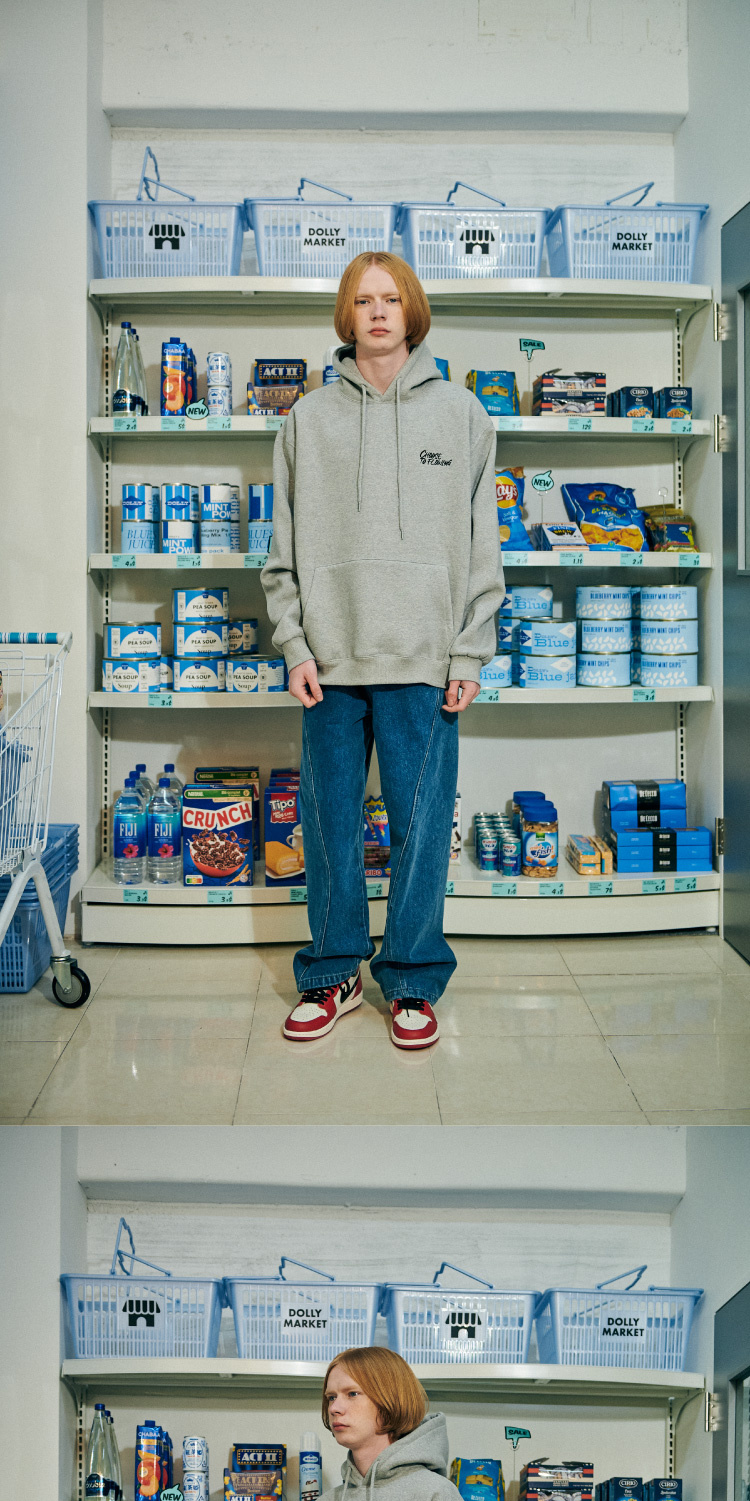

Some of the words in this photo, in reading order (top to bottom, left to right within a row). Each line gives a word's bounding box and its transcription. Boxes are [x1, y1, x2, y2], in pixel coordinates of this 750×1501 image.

[308, 228, 341, 236] DOLLY
[616, 232, 648, 240] DOLLY
[303, 238, 346, 247] MARKET
[611, 242, 653, 251] MARKET
[263, 367, 285, 376] ACT
[286, 366, 298, 376] II
[187, 407, 207, 415] NEW
[533, 478, 551, 488] NEW
[203, 503, 229, 512] MINT
[162, 539, 187, 547] MINT
[534, 638, 569, 648] Blue
[527, 671, 563, 681] Blue
[269, 798, 295, 812] Tipo
[183, 802, 252, 829] CRUNCH
[119, 823, 138, 837] FIJI
[154, 823, 173, 837] FIJI
[288, 1308, 322, 1318] DOLLY
[283, 1318, 328, 1329] MARKET
[607, 1317, 640, 1327] DOLLY
[602, 1327, 645, 1337] MARKET
[242, 1451, 263, 1462] ACT
[264, 1451, 278, 1461] II
[162, 1493, 182, 1501] NEW
